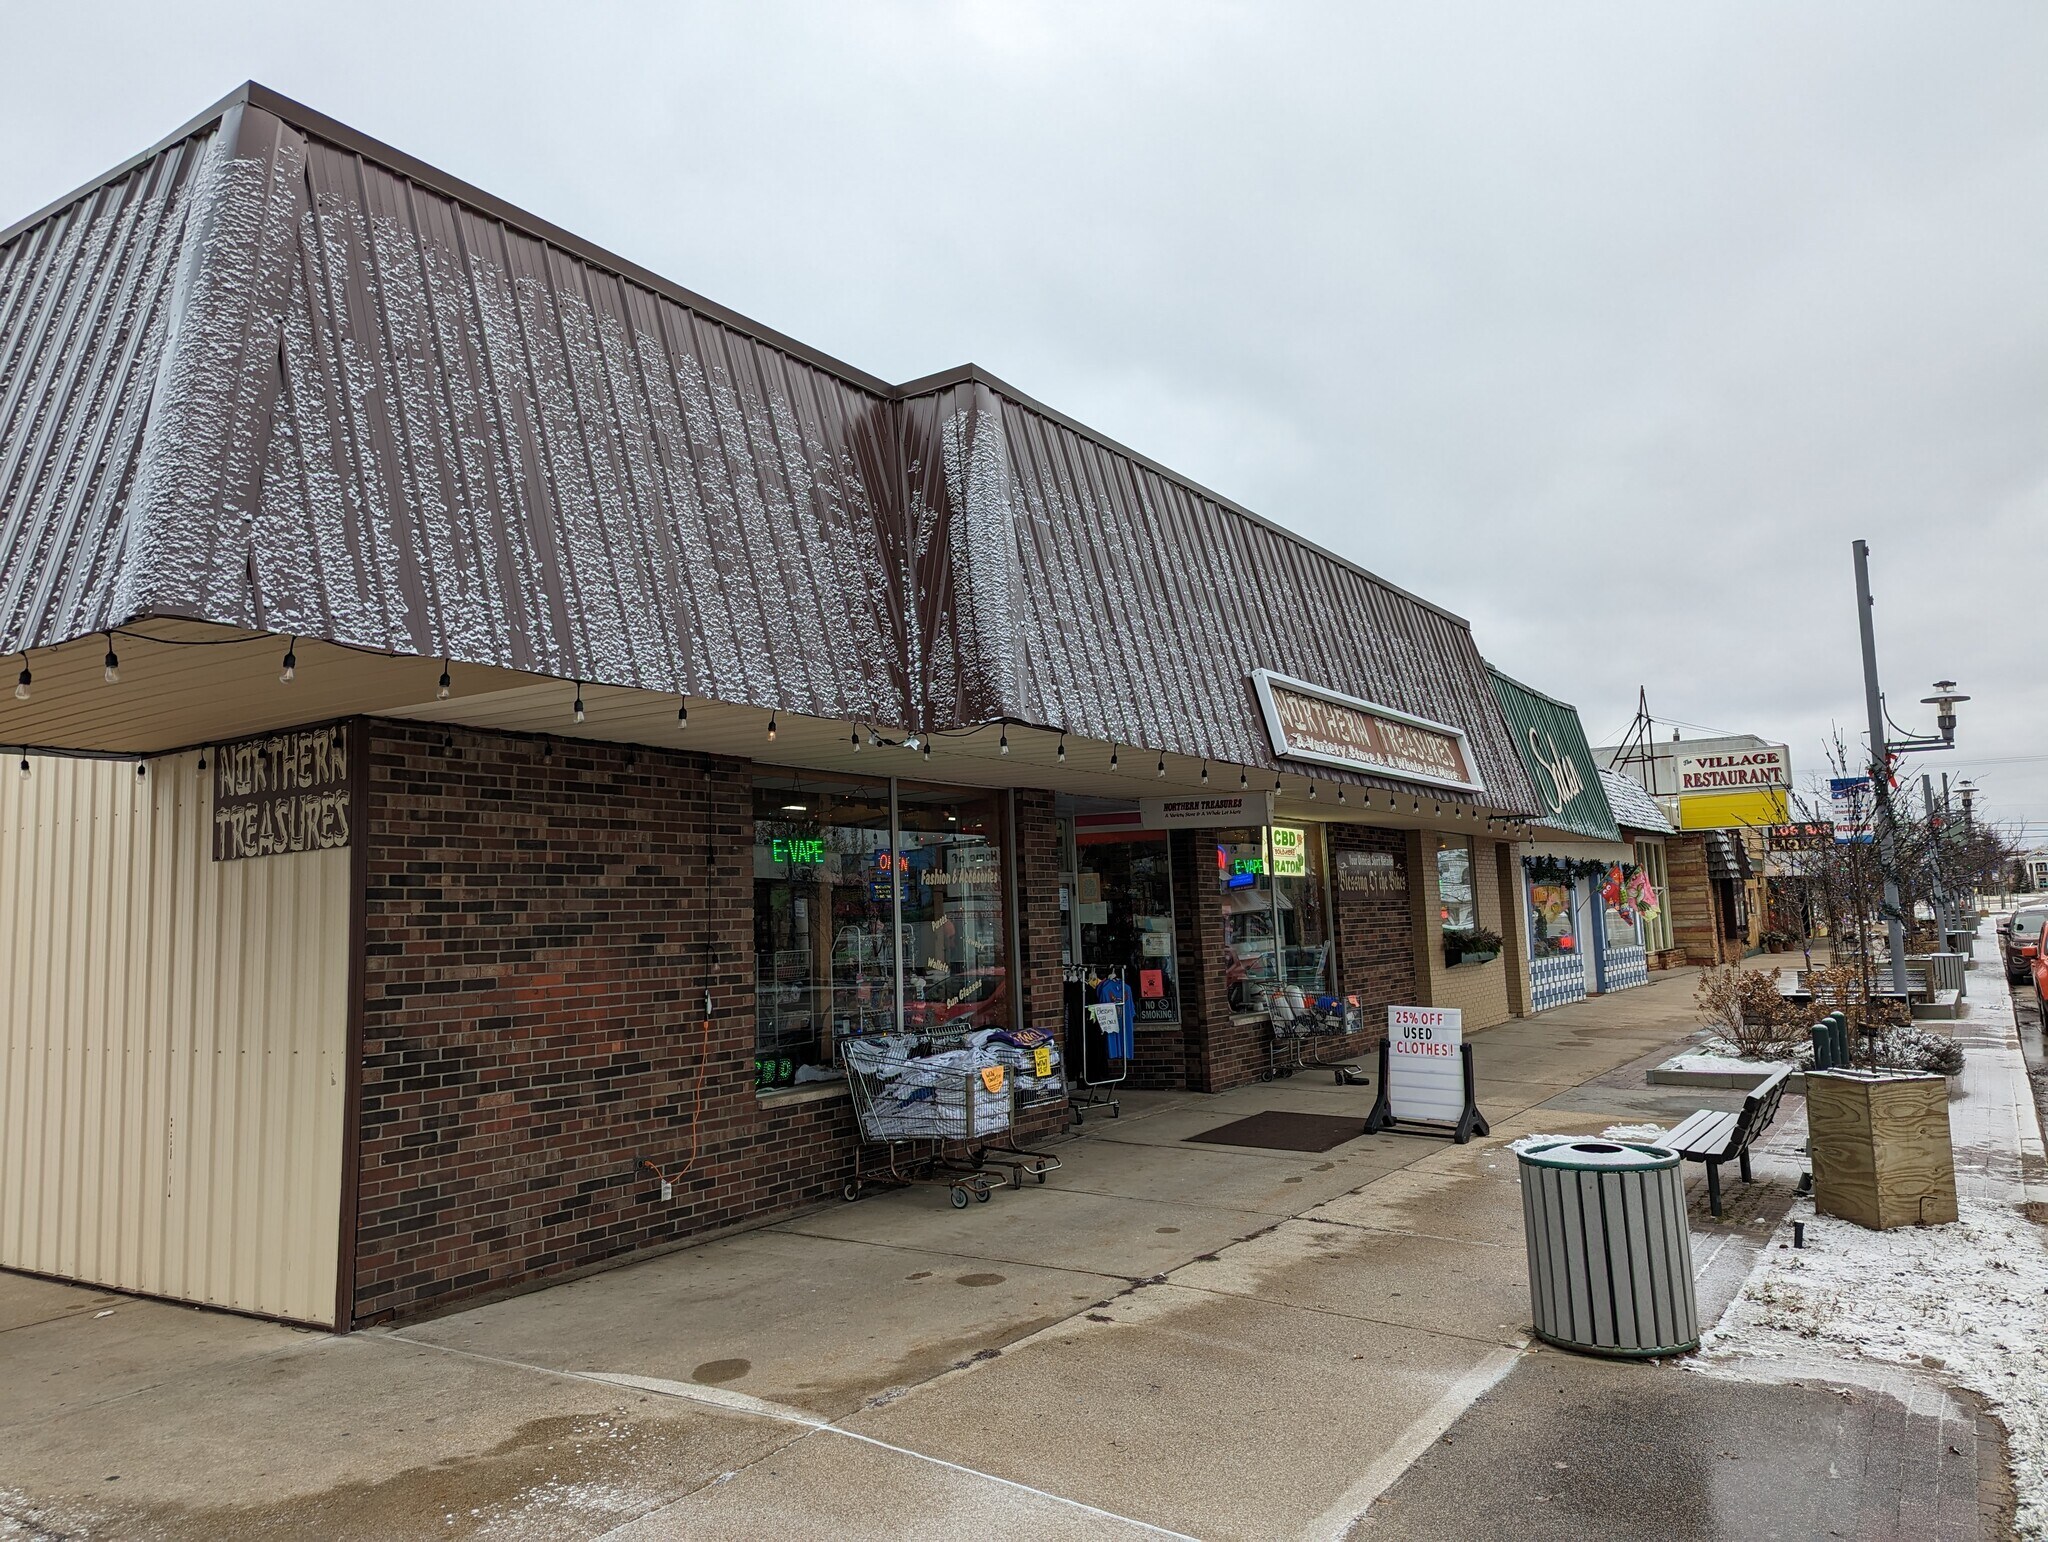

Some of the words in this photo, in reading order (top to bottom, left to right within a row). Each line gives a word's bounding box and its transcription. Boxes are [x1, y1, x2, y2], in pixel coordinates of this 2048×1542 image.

[1271, 685, 1371, 747] NORTHERN
[1373, 717, 1456, 768] TREASURES
[220, 726, 347, 798] NORTHERN
[1683, 758, 1692, 766] The
[1695, 752, 1780, 768] VILLAGE
[1683, 767, 1782, 788] RESTAURANT
[1163, 800, 1200, 812] NORTHERN
[1201, 798, 1243, 810] TREASURES
[215, 789, 350, 860] TREASURES
[1836, 823, 1873, 833] WELCME
[1273, 829, 1296, 847] CBD
[772, 839, 825, 863] E-VAPE
[879, 854, 910, 873] ON
[1234, 858, 1264, 875] E-VAPE
[1273, 860, 1302, 873] RATOM
[921, 868, 951, 886] Fashion
[952, 868, 958, 884] &
[932, 914, 948, 932] Purses
[927, 957, 949, 973] Wallets
[946, 995, 959, 1010] Sun
[959, 978, 983, 1001] Glasses
[1145, 1000, 1155, 1010] NO
[1141, 1010, 1172, 1020] SMOKING
[1395, 1011, 1418, 1025] 25%
[1421, 1013, 1443, 1026] OFF
[1403, 1026, 1432, 1040] USED
[1396, 1041, 1454, 1057] CLOTHES!
[754, 1058, 793, 1085] BD
